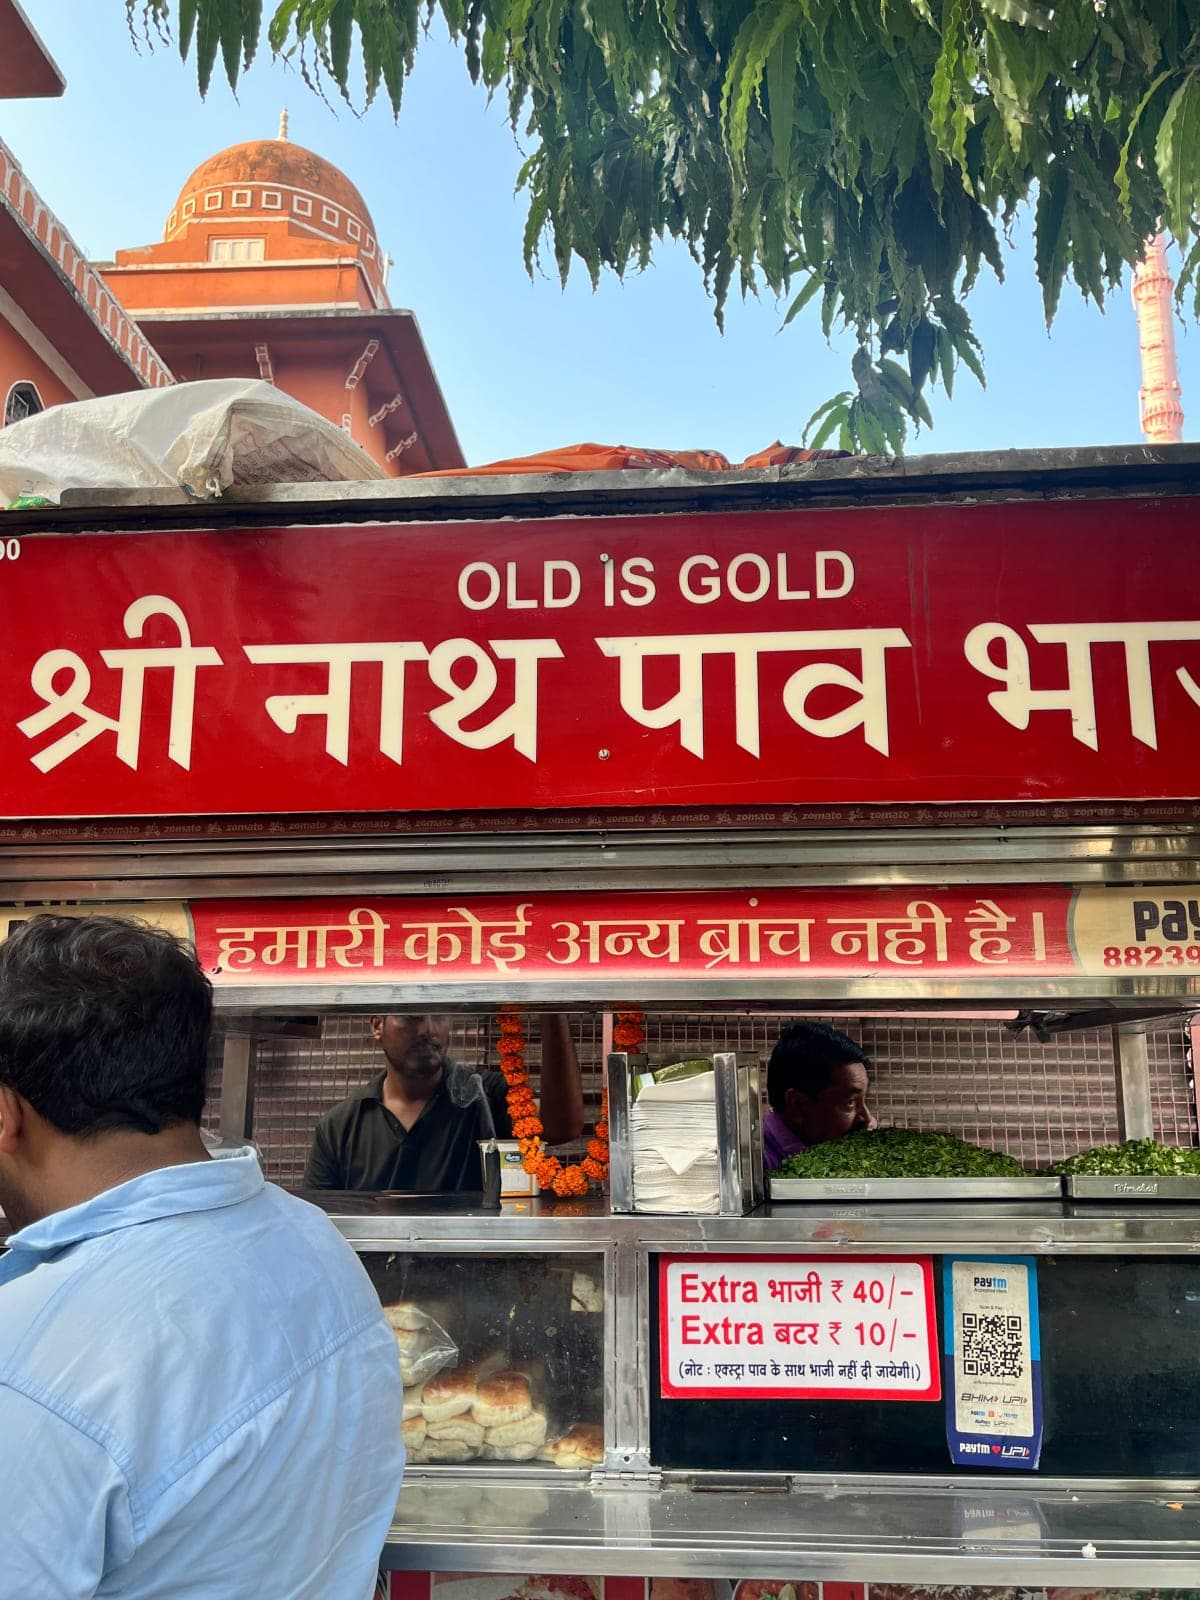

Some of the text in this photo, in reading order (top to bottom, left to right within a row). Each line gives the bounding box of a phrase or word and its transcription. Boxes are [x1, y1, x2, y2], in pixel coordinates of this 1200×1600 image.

[458, 550, 855, 611] OLD IS GOLD
[16, 595, 1200, 774] श्री नाथ पाव भा
[802, 811, 842, 821] zomato
[215, 906, 391, 974] हमारी
[402, 903, 534, 974] कोई
[546, 919, 686, 965] अन्य
[696, 896, 816, 969] ब्रांच
[826, 899, 953, 966] नही
[1103, 945, 1200, 969] 88239
[680, 1270, 914, 1310] Extra भाजी ₹ 40/-
[680, 1314, 918, 1352] Extra बटर ₹ 10/-
[678, 1358, 703, 1379] (नोट
[715, 1363, 744, 1382] एक्स्ट्रा
[748, 1363, 767, 1377] पाव
[770, 1359, 781, 1377] के
[784, 1363, 806, 1378] साथ
[809, 1359, 835, 1378] भाजी
[837, 1359, 858, 1380] नहीं
[860, 1359, 873, 1381] दी
[1001, 1445, 1026, 1457] UPI
